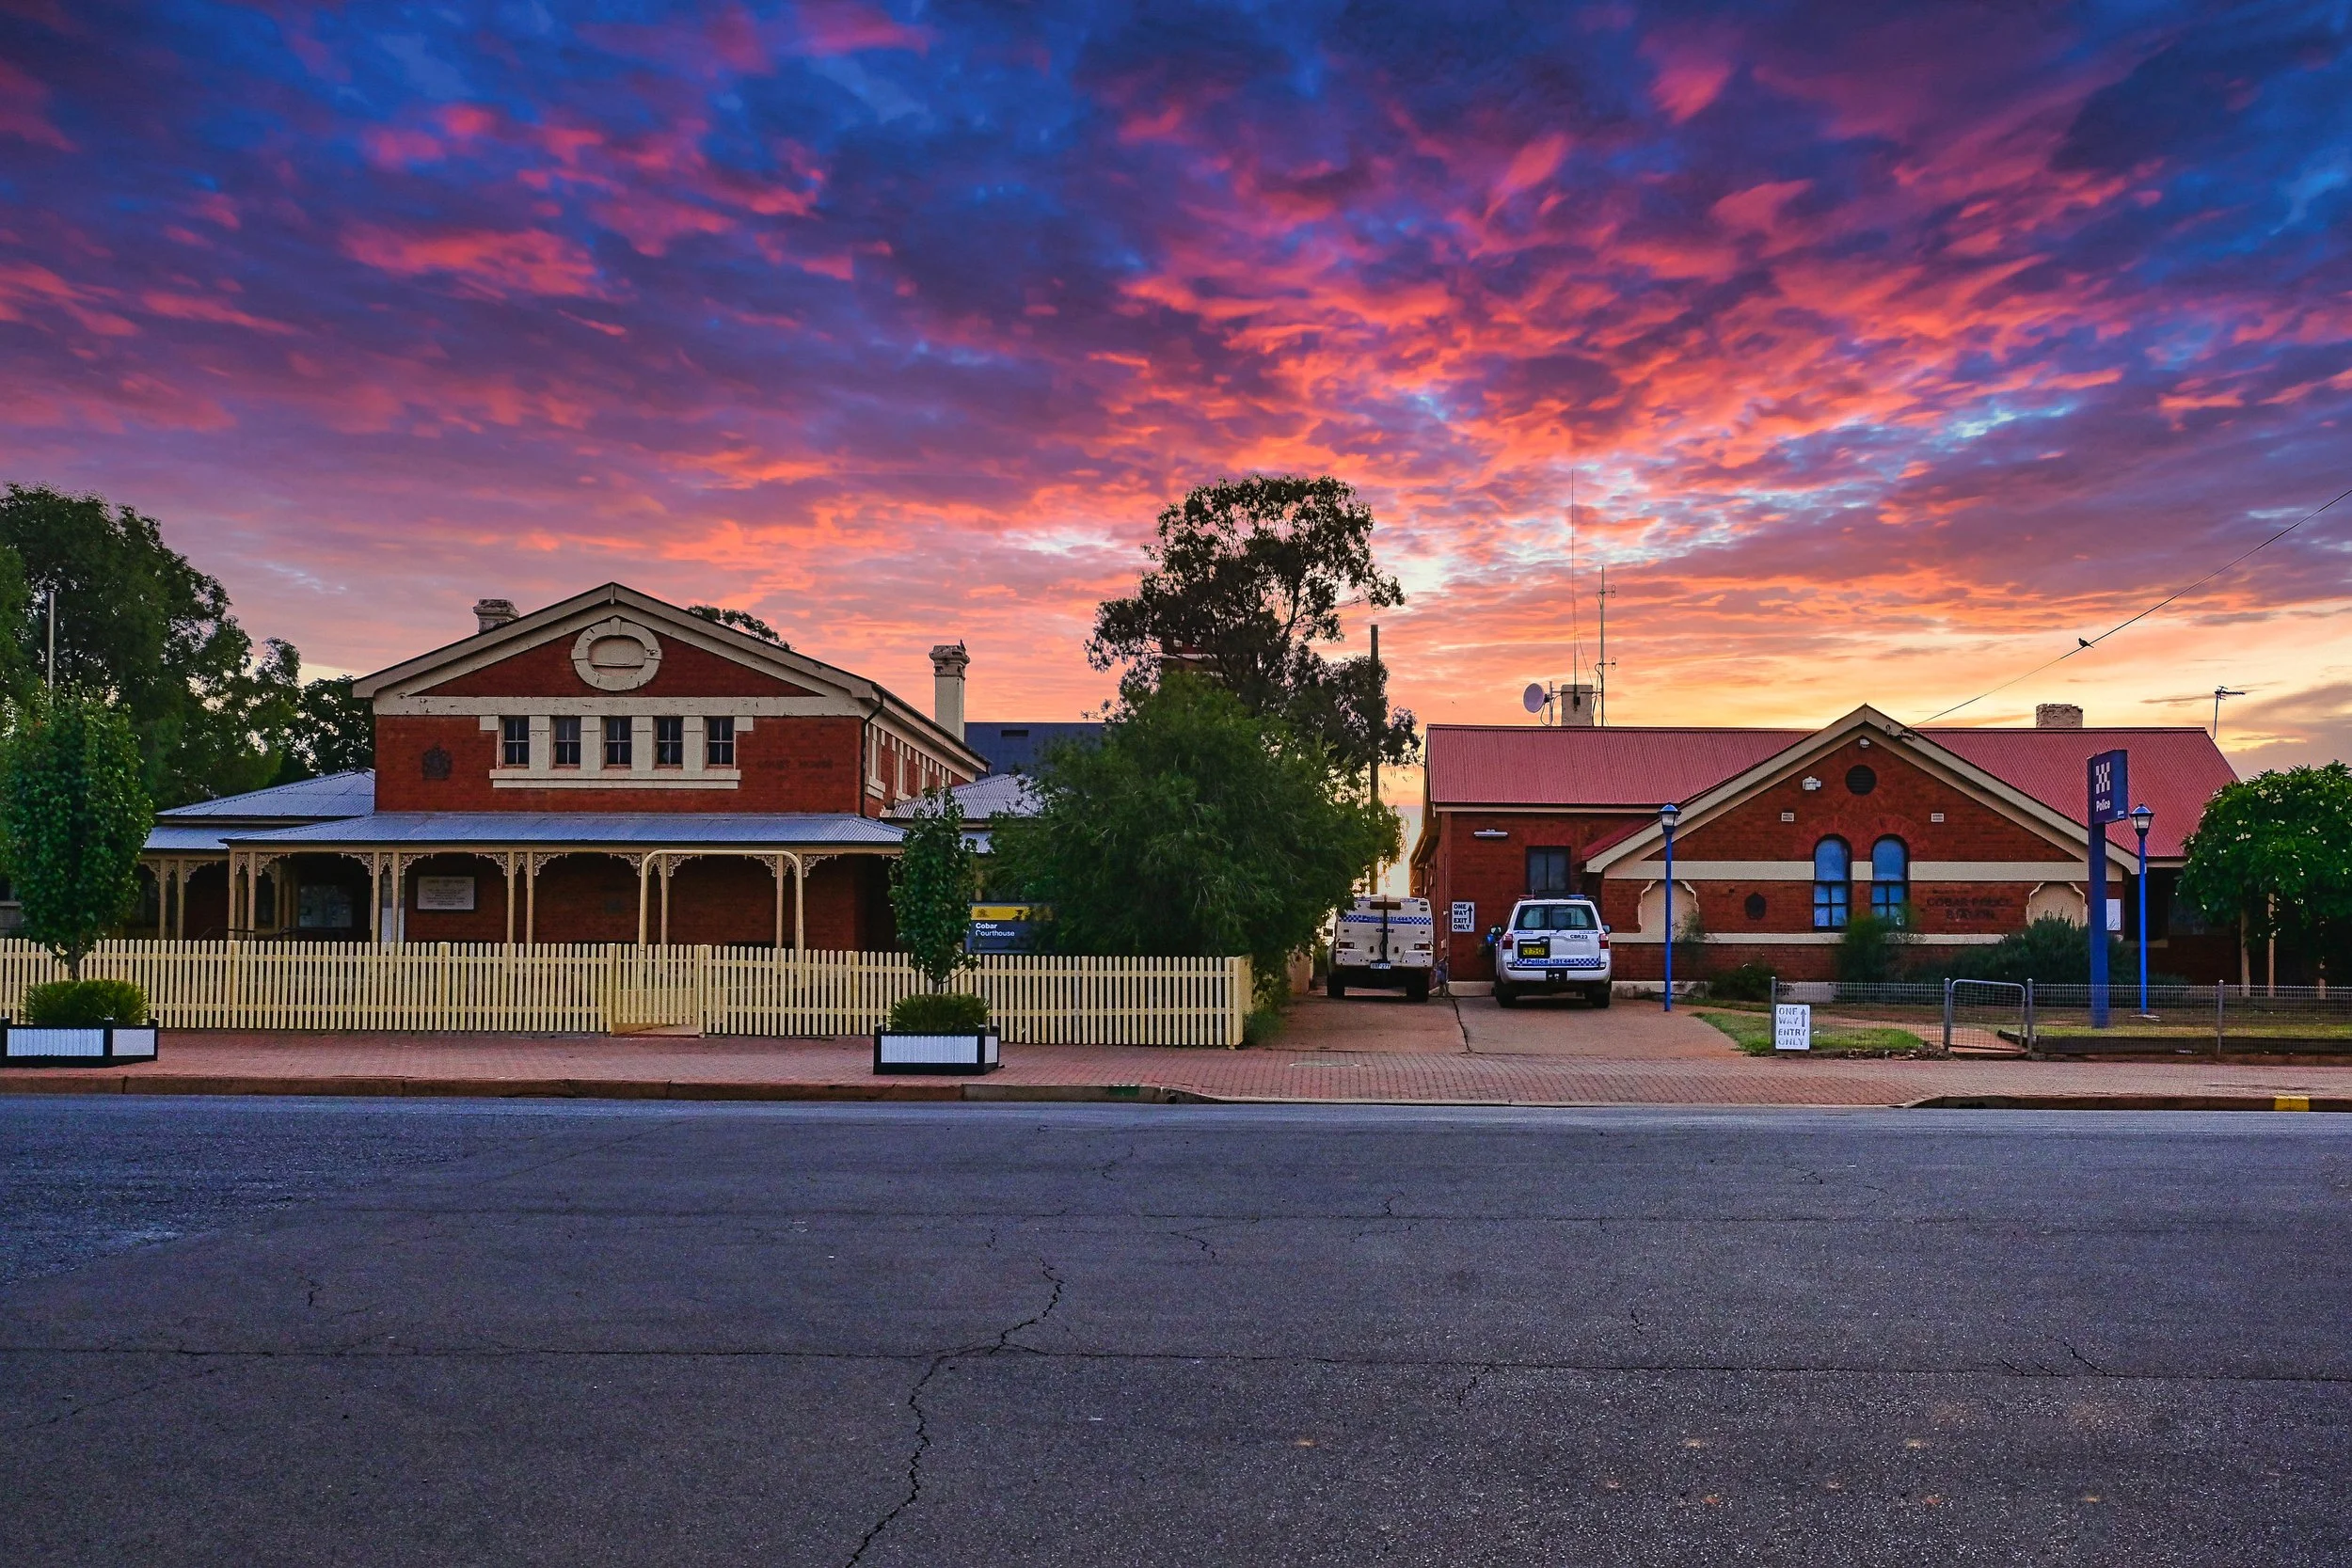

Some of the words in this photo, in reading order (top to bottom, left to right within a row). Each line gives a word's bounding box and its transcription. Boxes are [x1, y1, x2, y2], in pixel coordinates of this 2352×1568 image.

[2096, 799, 2111, 813] Police
[1778, 1016, 1799, 1024] WAY
[1778, 1028, 1806, 1037] ENTRY
[1778, 1037, 1804, 1046] ONLY
